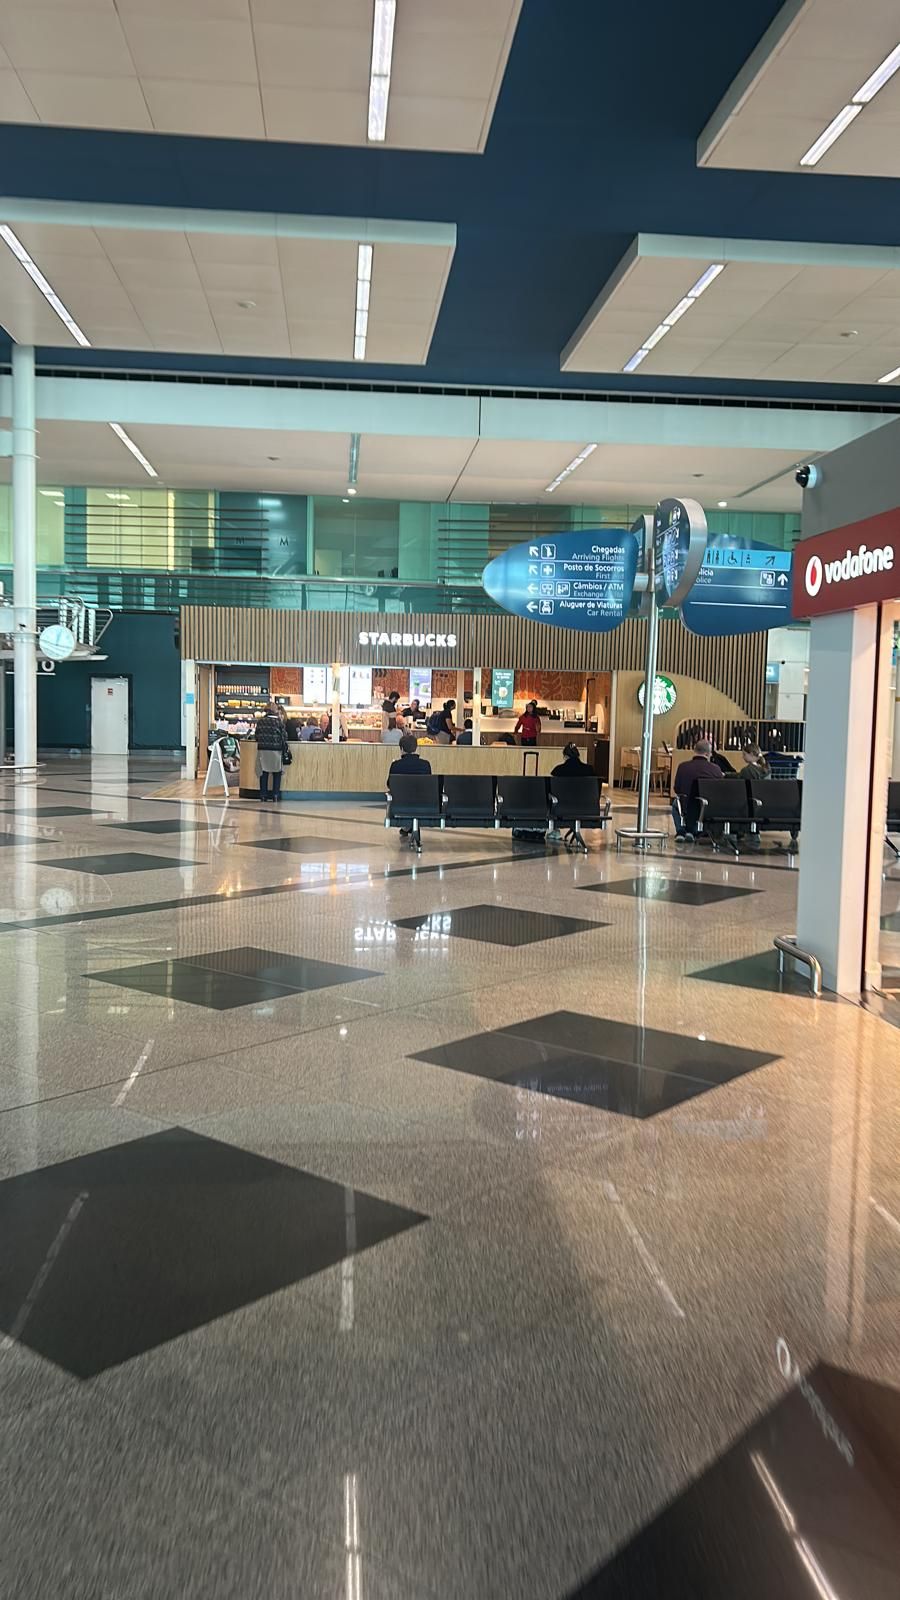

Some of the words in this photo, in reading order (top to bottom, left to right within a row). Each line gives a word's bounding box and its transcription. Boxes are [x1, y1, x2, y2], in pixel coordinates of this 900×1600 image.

[591, 545, 625, 554] Chegadas
[571, 553, 600, 562] Arriving
[563, 563, 583, 571] Posto
[584, 563, 594, 571] de
[595, 564, 624, 572] Socorros
[825, 545, 894, 584] vodafone
[573, 582, 602, 590] Câmbios
[608, 583, 624, 592] ATM
[573, 590, 604, 598] Exchange
[560, 600, 586, 609] Aluguer
[587, 601, 596, 609] de
[597, 602, 623, 610] Viaturas
[600, 609, 623, 617] Rental
[358, 632, 457, 647] STARBUCKS
